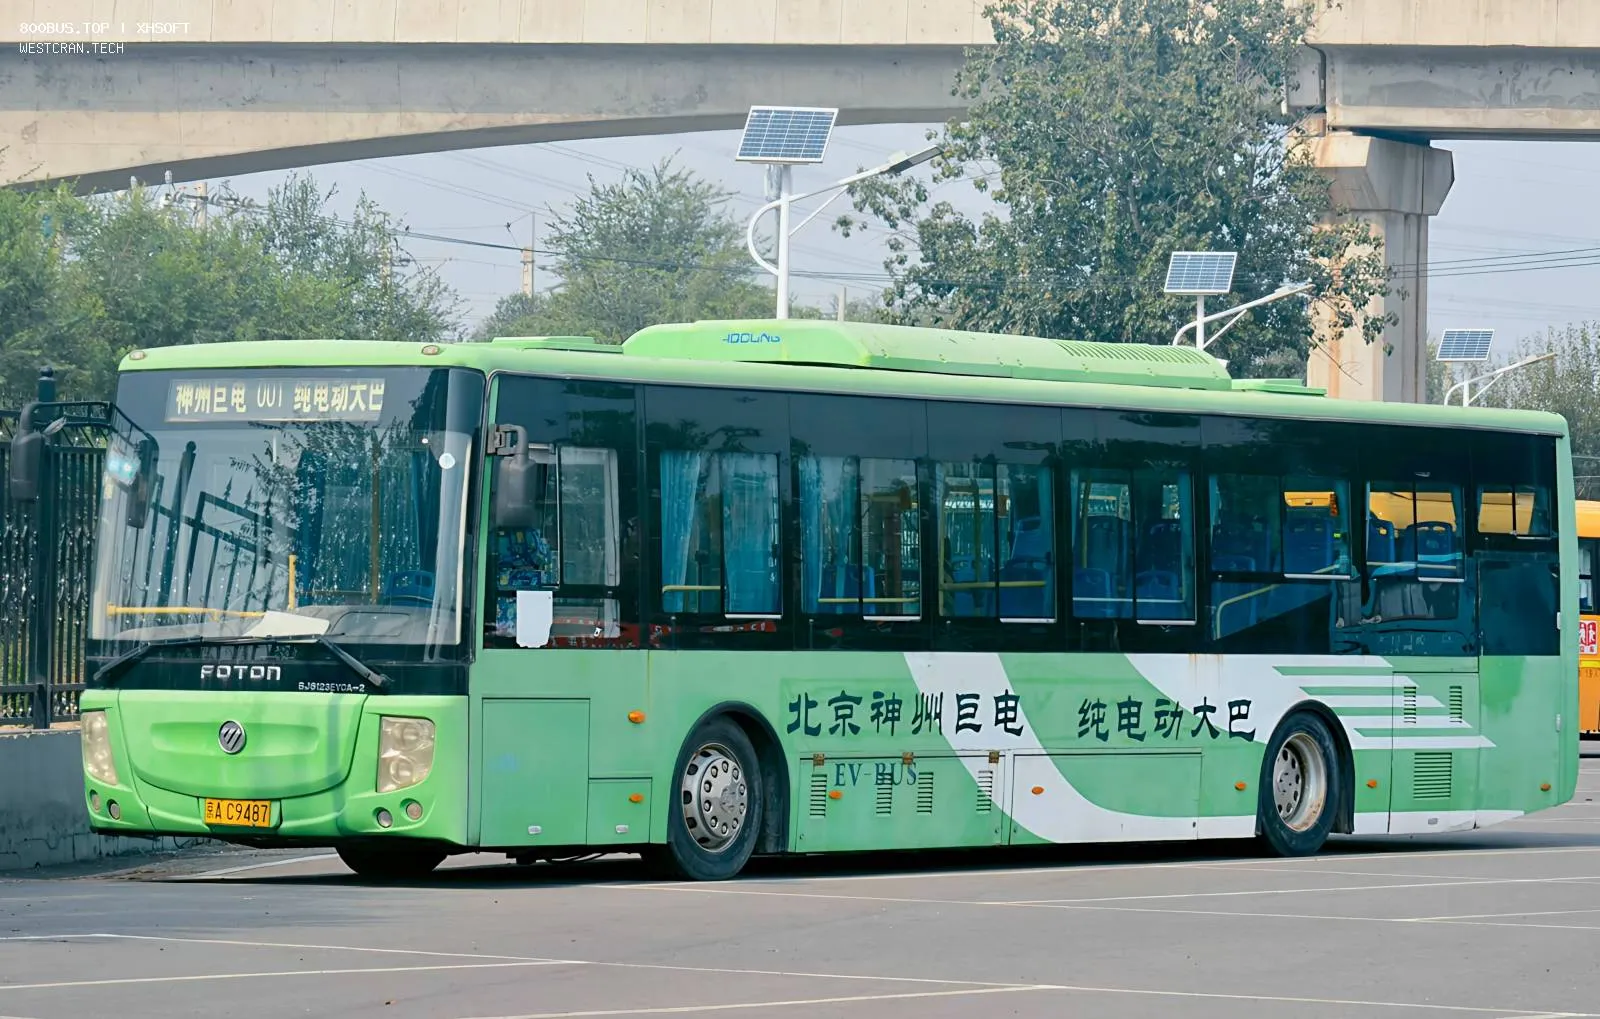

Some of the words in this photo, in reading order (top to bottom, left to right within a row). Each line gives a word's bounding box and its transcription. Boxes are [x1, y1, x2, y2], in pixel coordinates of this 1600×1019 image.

[175, 382, 248, 414] 神州巨电
[292, 382, 385, 413] 纯电动大巴
[200, 664, 282, 681] FOTON
[786, 689, 1025, 737] 北京神州巨电
[1077, 695, 1257, 742] 纯电动大巴
[834, 762, 918, 787] EV-BUS
[226, 802, 269, 823] C9487
